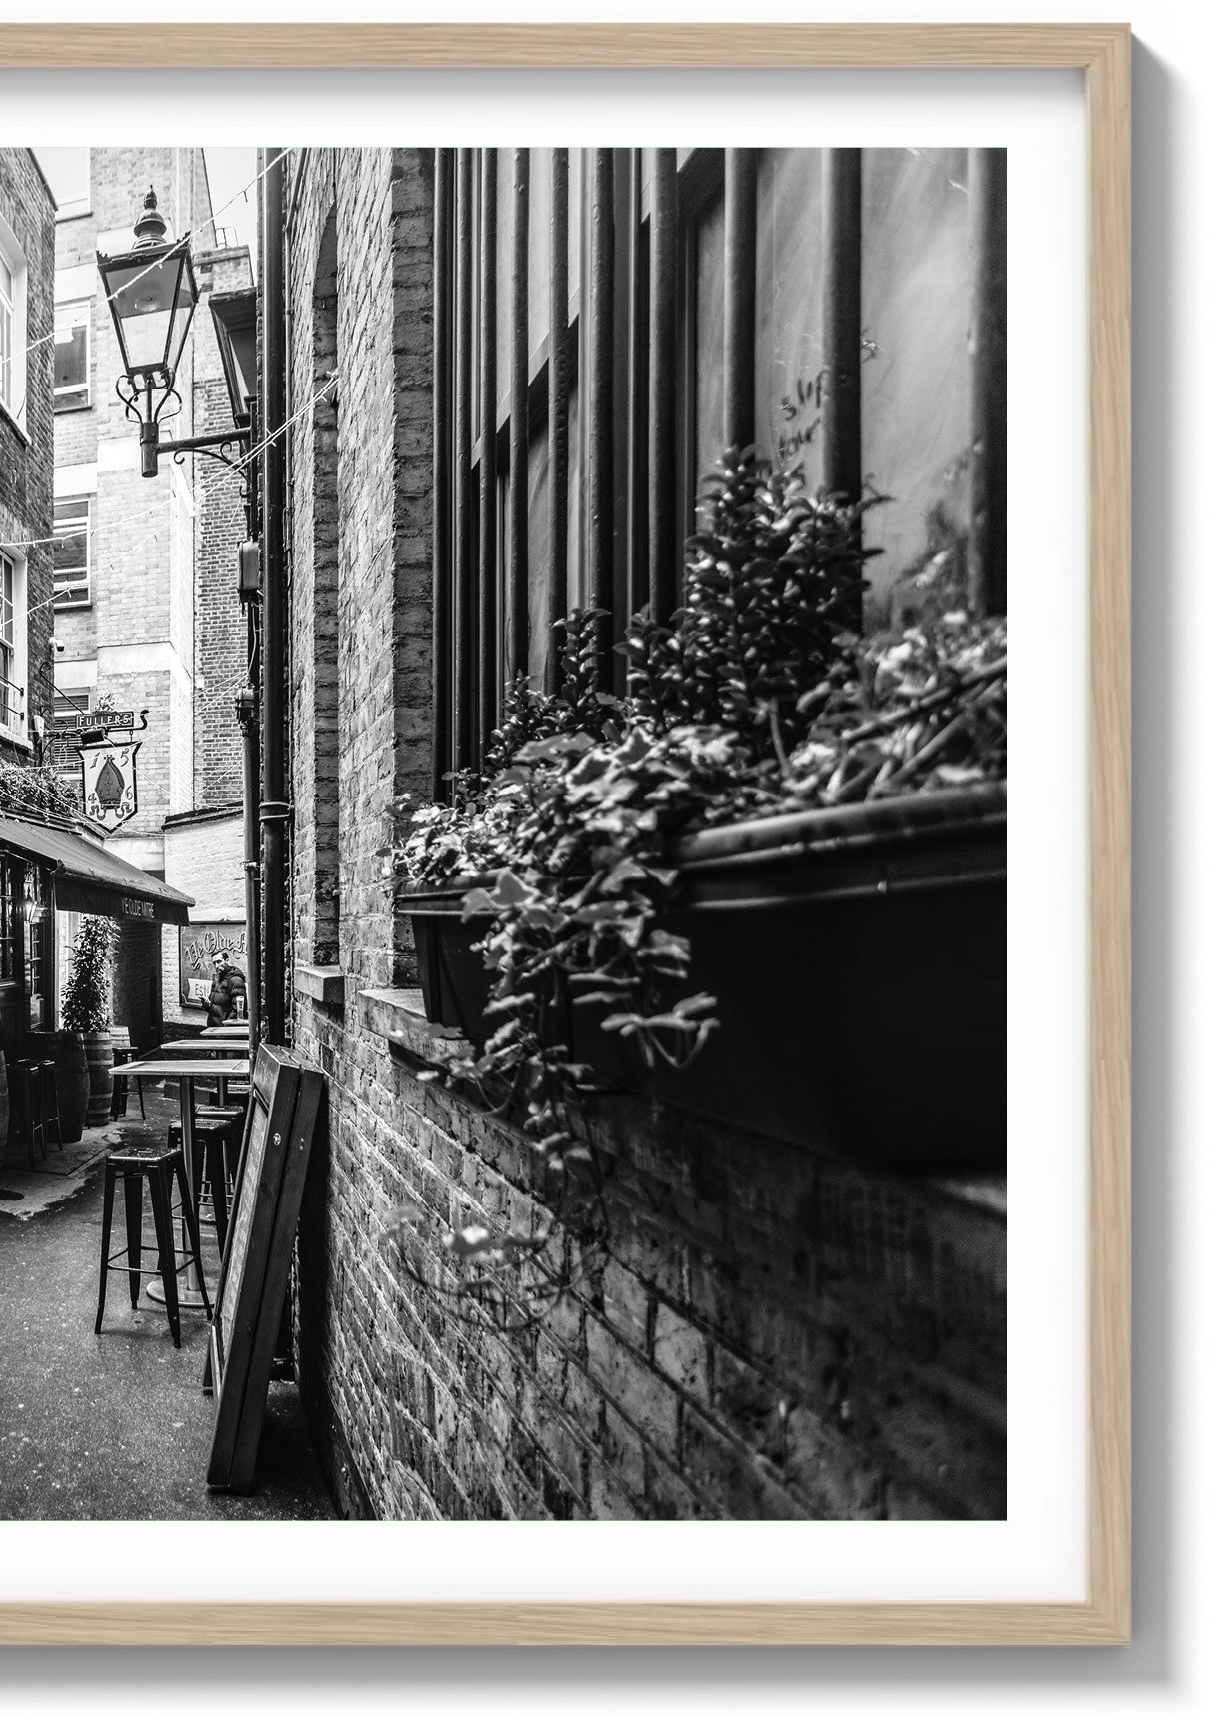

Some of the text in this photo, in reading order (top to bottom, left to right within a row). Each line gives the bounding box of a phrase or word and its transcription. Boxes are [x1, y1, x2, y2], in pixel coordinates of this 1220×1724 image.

[120, 747, 130, 768] 5
[87, 785, 134, 804] 4 6
[121, 896, 129, 914] YE
[129, 898, 141, 917] OLDE
[185, 941, 205, 971] Ye
[204, 931, 234, 956] Olde
